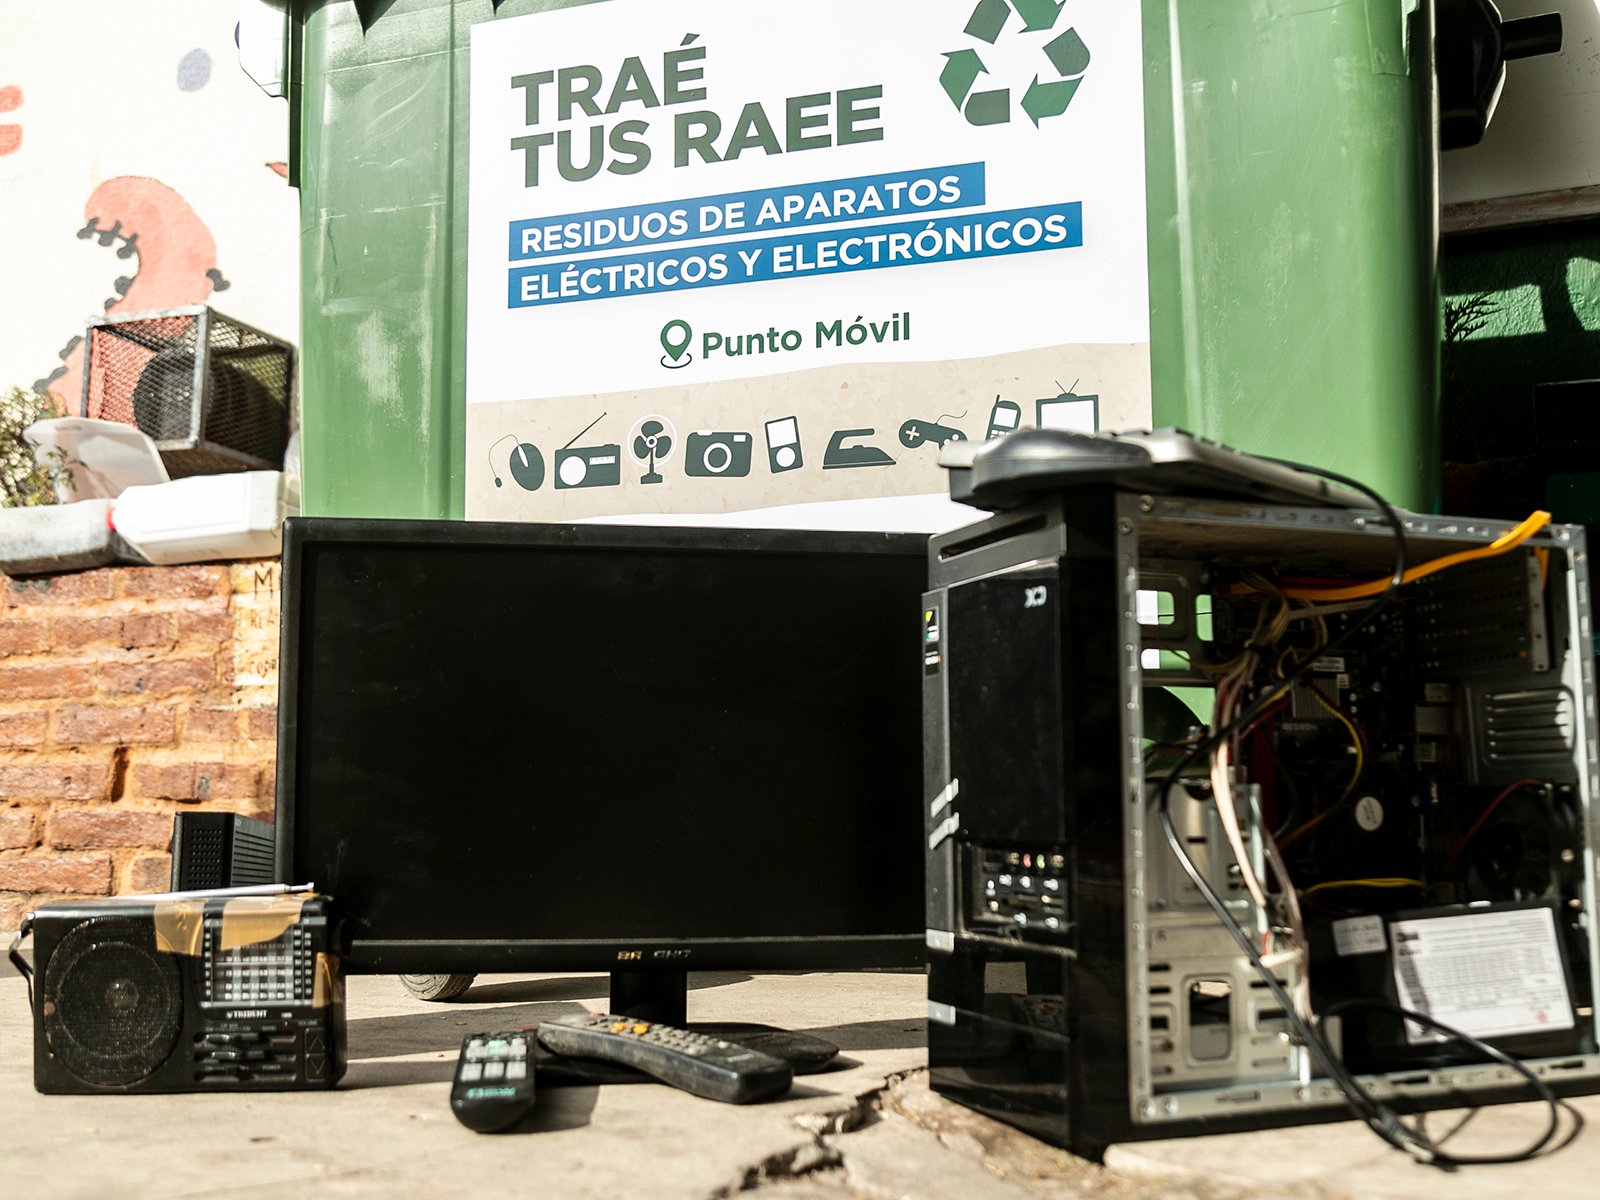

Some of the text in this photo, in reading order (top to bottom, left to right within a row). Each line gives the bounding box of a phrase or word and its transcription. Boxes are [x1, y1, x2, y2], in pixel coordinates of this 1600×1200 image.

[511, 32, 707, 126] TRAÉ
[510, 84, 884, 188] TUS RAEE
[521, 175, 961, 254] RESIDUOS DE APARATOS
[521, 214, 1067, 301] ELÉCTRICOS Y ELECTRÓNICOS
[702, 312, 910, 359] Punto Móvil
[233, 1009, 267, 1018] TRIDENT
